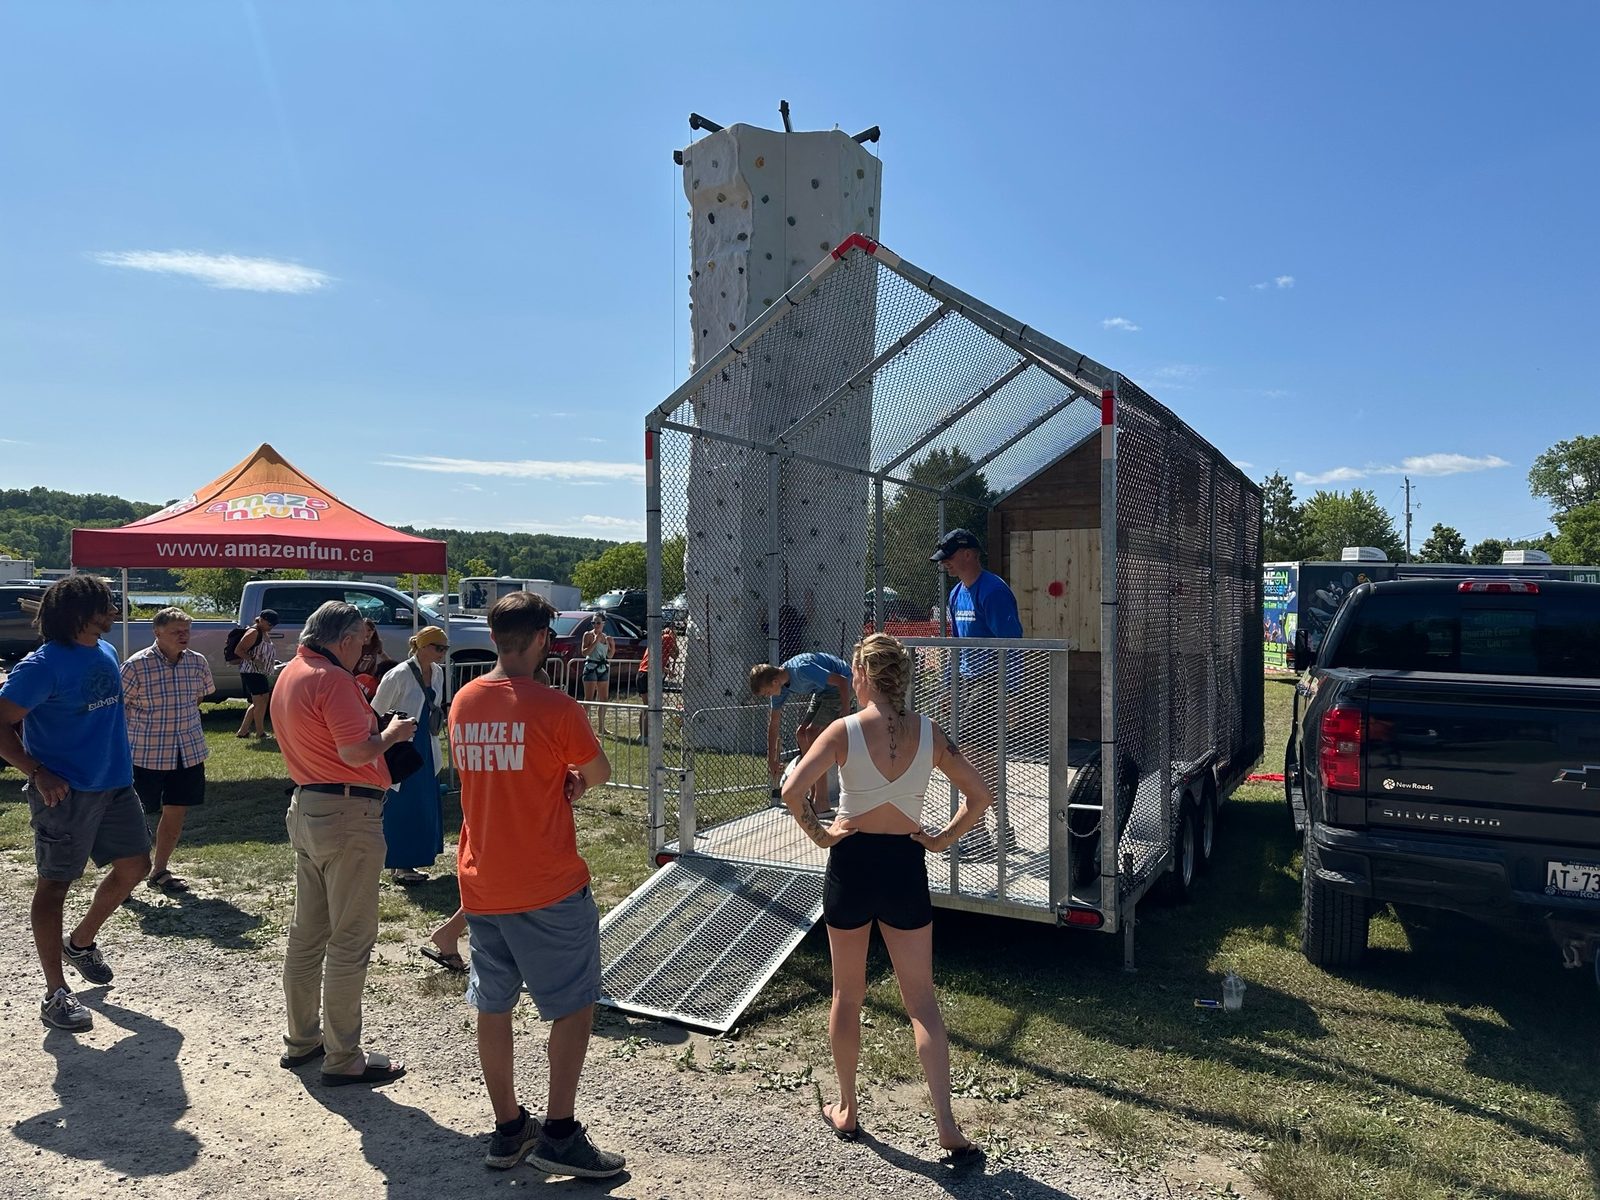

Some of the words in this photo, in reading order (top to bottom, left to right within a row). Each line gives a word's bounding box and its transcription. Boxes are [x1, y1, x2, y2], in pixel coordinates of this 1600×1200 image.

[156, 541, 374, 562] www.amazenfun.ca
[1574, 574, 1585, 583] UP
[511, 722, 526, 743] N
[455, 744, 525, 771] CREW
[1396, 781, 1411, 789] New
[1412, 782, 1434, 791] Roads
[1383, 809, 1501, 826] SILVERADO
